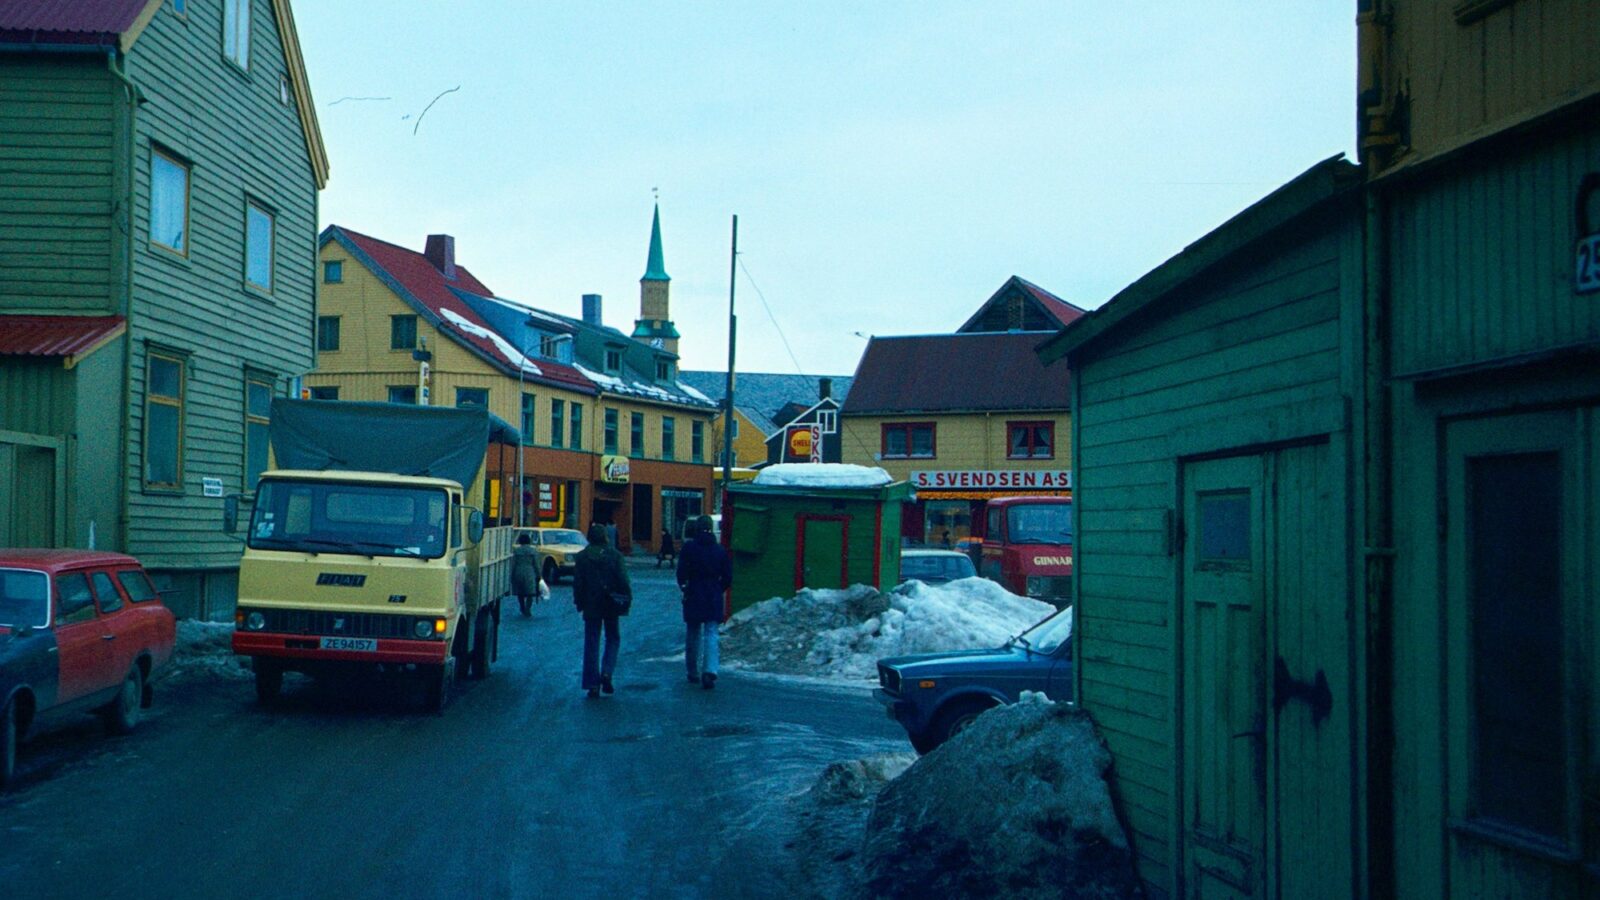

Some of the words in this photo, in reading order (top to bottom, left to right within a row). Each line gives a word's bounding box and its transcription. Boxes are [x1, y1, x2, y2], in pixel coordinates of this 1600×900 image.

[918, 472, 931, 486] S.
[935, 472, 1036, 486] SVENDSEN
[319, 573, 363, 586] FIAT
